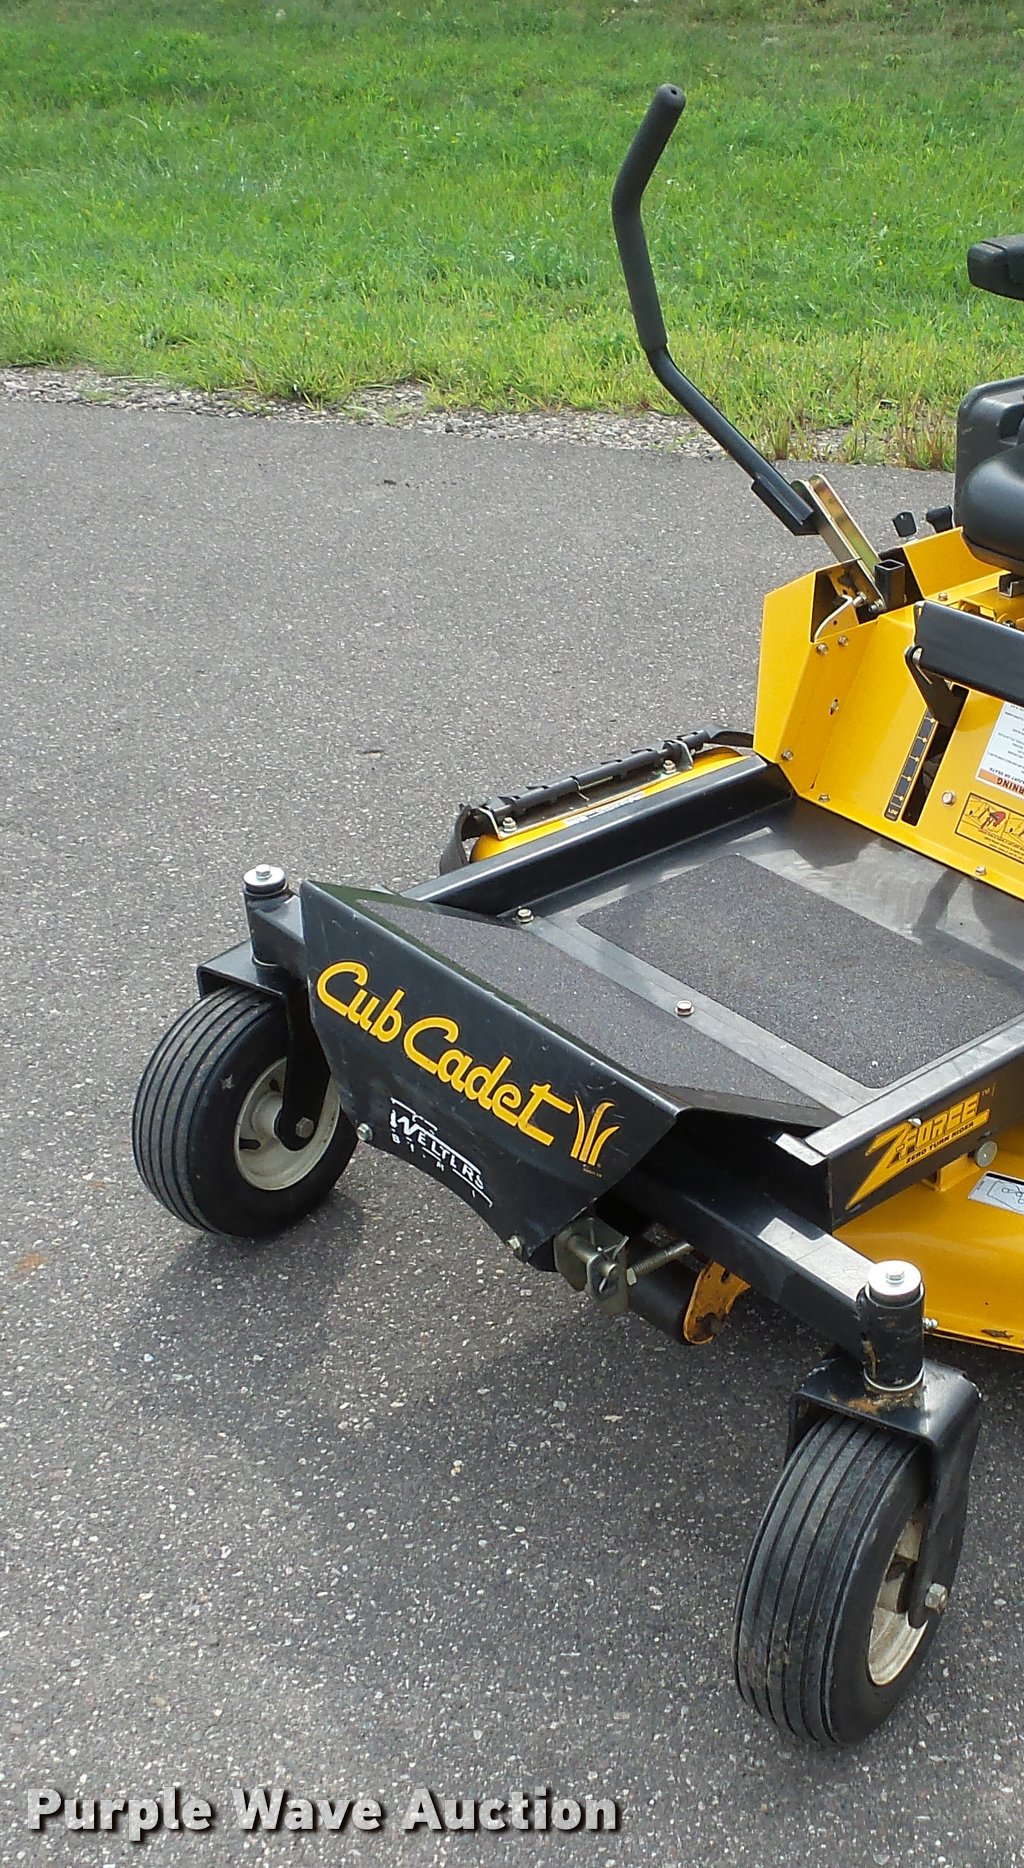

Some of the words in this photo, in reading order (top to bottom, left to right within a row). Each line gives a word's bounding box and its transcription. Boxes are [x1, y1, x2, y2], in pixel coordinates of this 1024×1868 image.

[316, 961, 405, 1043] Cub
[403, 1016, 574, 1146] Cadet
[906, 1148, 927, 1164] ZERO
[929, 1136, 950, 1151] TURN
[951, 1121, 975, 1138] RIDER
